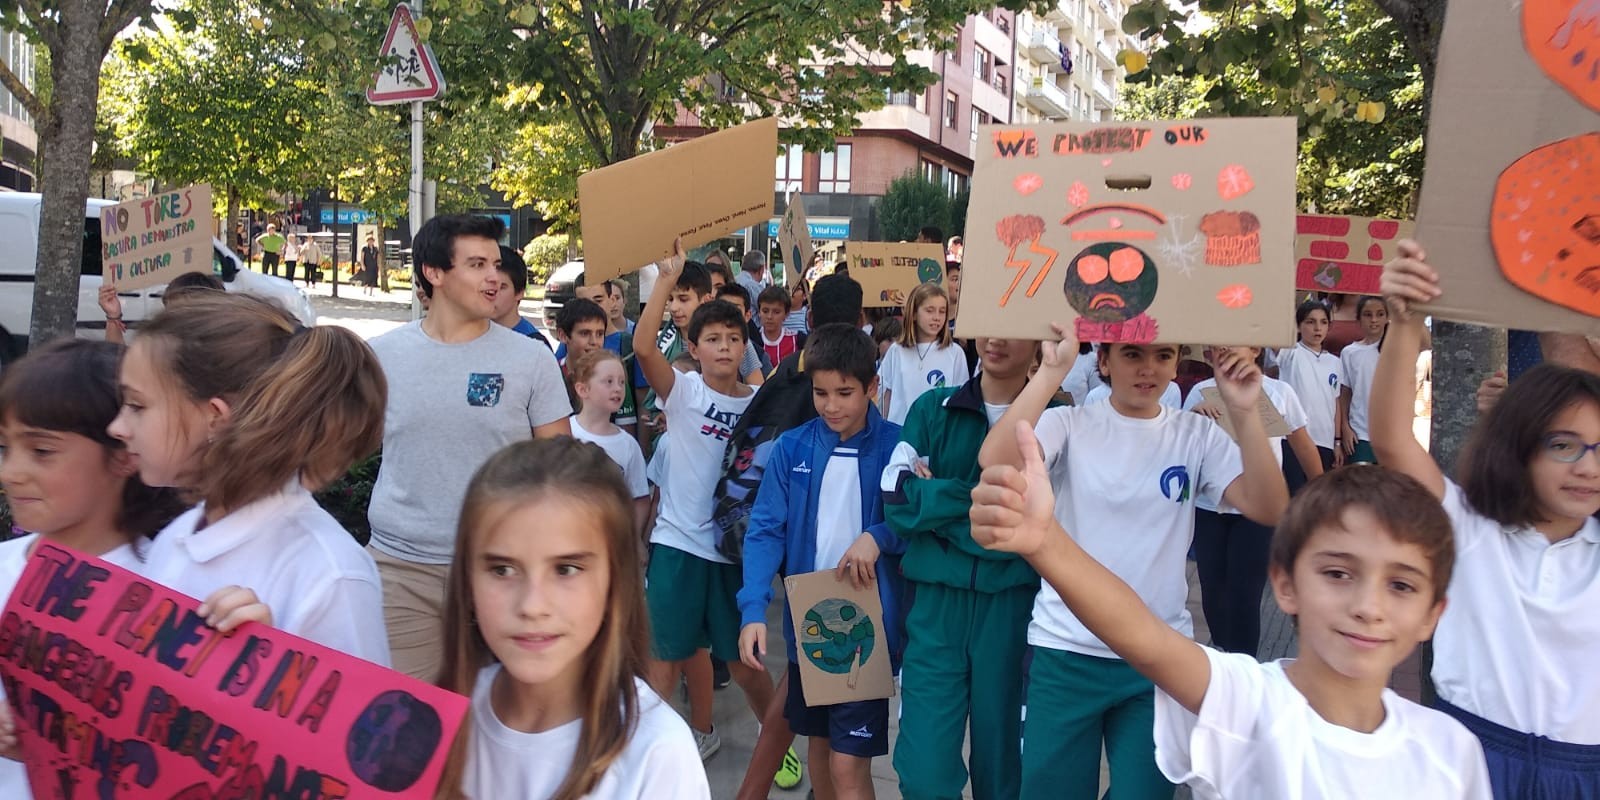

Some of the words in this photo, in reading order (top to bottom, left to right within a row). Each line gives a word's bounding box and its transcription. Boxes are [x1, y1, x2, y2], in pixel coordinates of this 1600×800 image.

[997, 131, 1036, 157] WE
[1054, 128, 1152, 153] PROTECT
[1165, 126, 1206, 145] OUR
[105, 207, 129, 236] NO
[141, 190, 192, 229] TIRES
[103, 235, 138, 260] BASURA
[141, 219, 195, 247] DEMUESTRA
[109, 263, 123, 284] TU
[130, 252, 172, 277] CULTURA
[20, 544, 111, 622] THE
[97, 581, 238, 678] PLANET
[217, 634, 273, 697] IS
[253, 648, 319, 719] IN
[296, 669, 342, 733] A
[136, 685, 259, 778] PROBLEM
